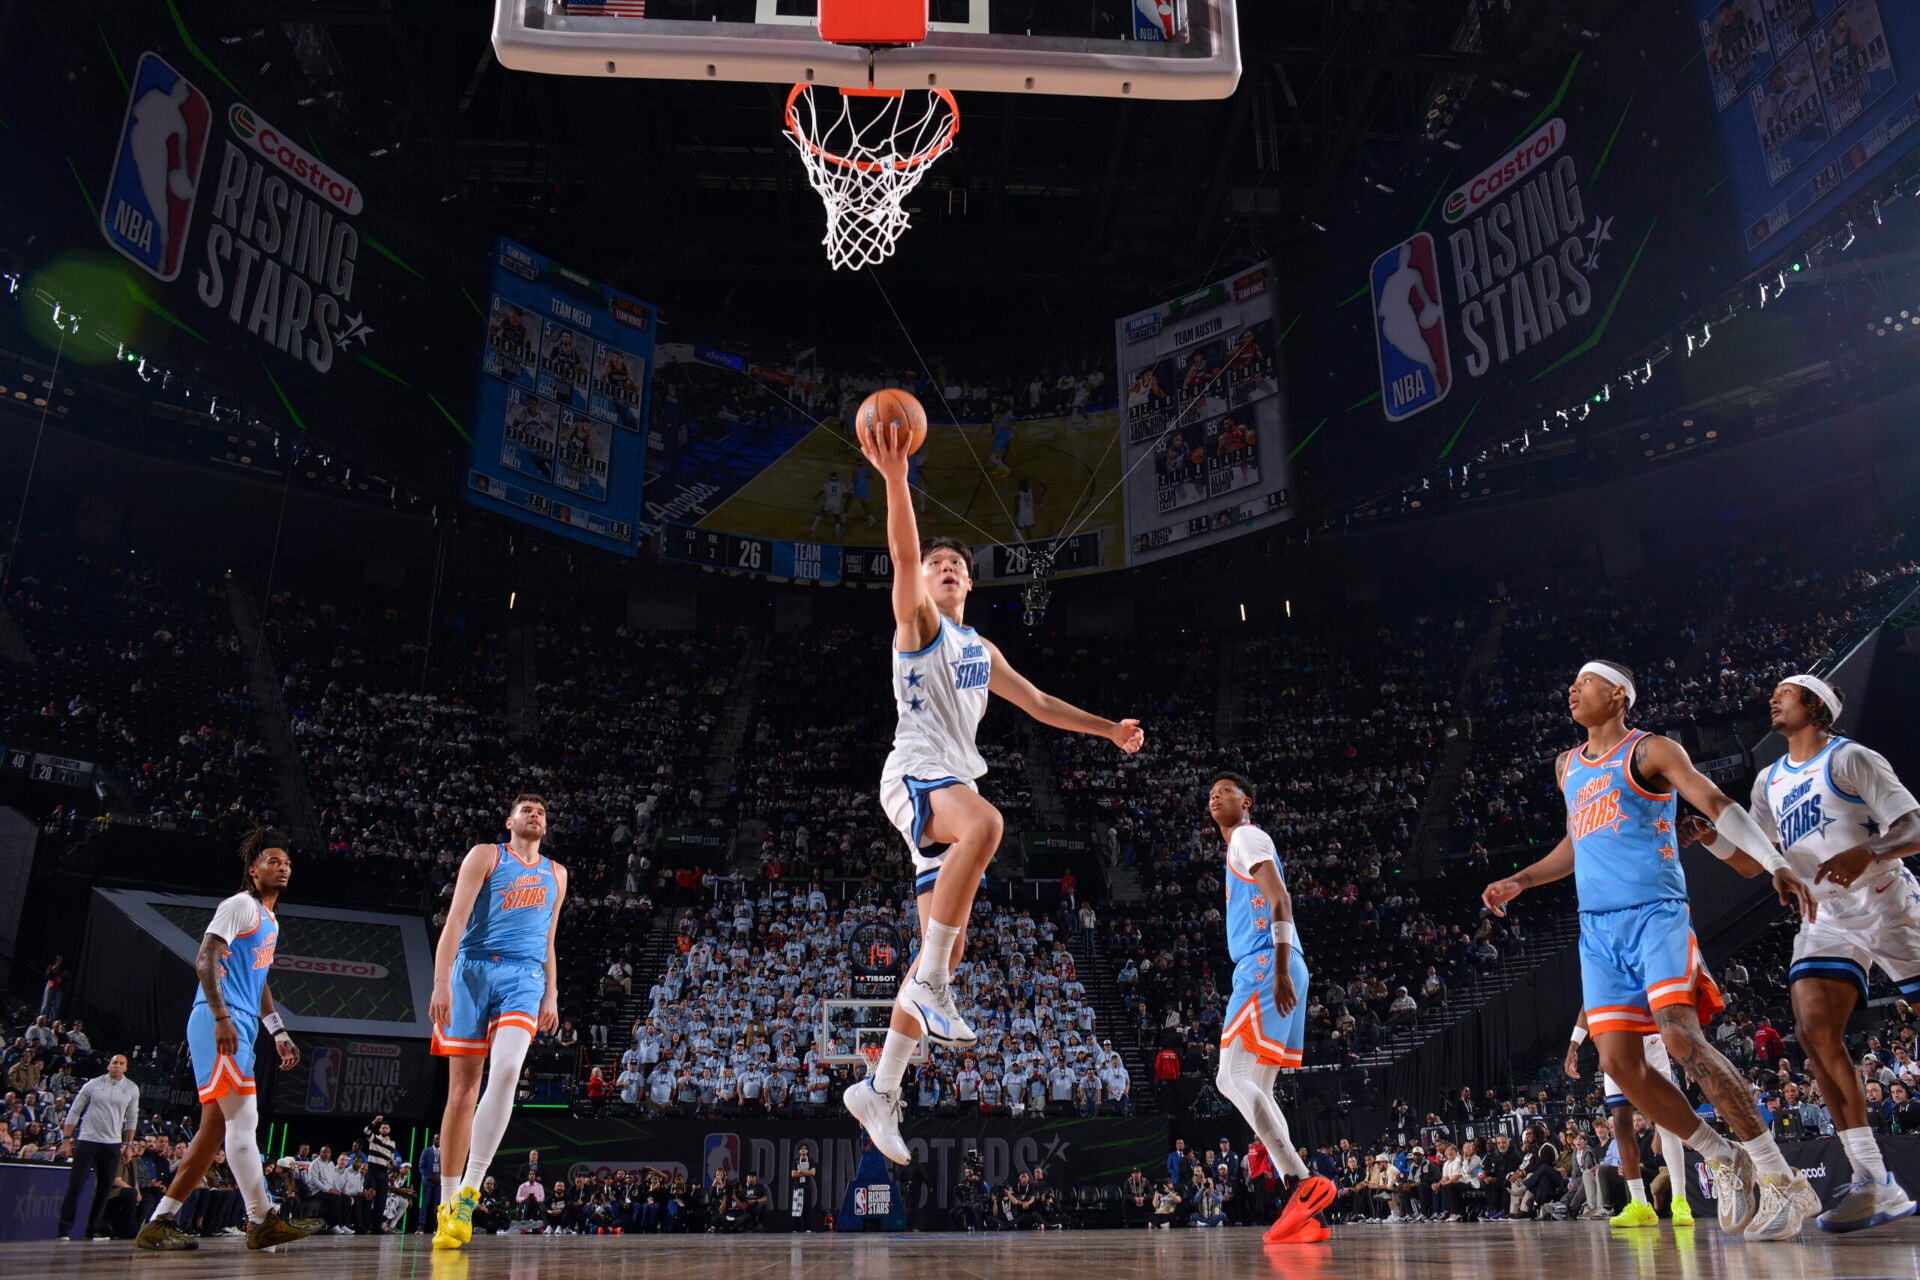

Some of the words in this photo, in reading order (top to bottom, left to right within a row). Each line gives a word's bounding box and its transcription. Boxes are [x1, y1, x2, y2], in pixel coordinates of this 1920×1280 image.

[1140, 28, 1160, 41] NBA
[1812, 28, 1827, 53] 23
[259, 128, 354, 208] Castrol
[1469, 123, 1556, 204] Castrol
[113, 199, 154, 254] NBA
[211, 139, 359, 303] RISING
[1447, 155, 1584, 304] RISING
[198, 223, 341, 374] STARS
[1461, 236, 1592, 377] STARS
[552, 298, 572, 320] TEAM
[572, 306, 592, 328] MELO
[546, 322, 552, 336] 5
[1174, 328, 1193, 346] TEAM
[1195, 316, 1222, 340] AUSTIN
[597, 344, 606, 359] 15
[1177, 354, 1186, 369] 16
[511, 387, 520, 404] 19
[563, 410, 573, 425] 23
[1207, 421, 1218, 437] 55
[645, 482, 720, 520] Angeles
[686, 529, 696, 540] FLS
[739, 540, 761, 569] 26
[793, 542, 821, 560] TEAM
[793, 561, 821, 580] MELO
[871, 554, 889, 576] 40
[956, 662, 989, 690] STARS
[11, 753, 26, 769] 40
[39, 765, 53, 780] 28
[1578, 771, 1613, 806] RISING
[1573, 789, 1621, 842] STARS
[1781, 794, 1822, 851] STARS
[516, 875, 542, 887] RISING
[502, 887, 547, 911] STARS
[274, 956, 376, 977] Castrol
[870, 943, 891, 967] 14
[359, 1044, 398, 1055] Castrol
[344, 1056, 400, 1086] RISING
[341, 1083, 395, 1113] STARS
[595, 1166, 680, 1187] Csol
[751, 1138, 893, 1211] RISIN
[1801, 1162, 1826, 1178] acock
[14, 1184, 64, 1225] xfinit
[868, 1190, 891, 1203] RISING
[868, 1202, 890, 1215] STARS
